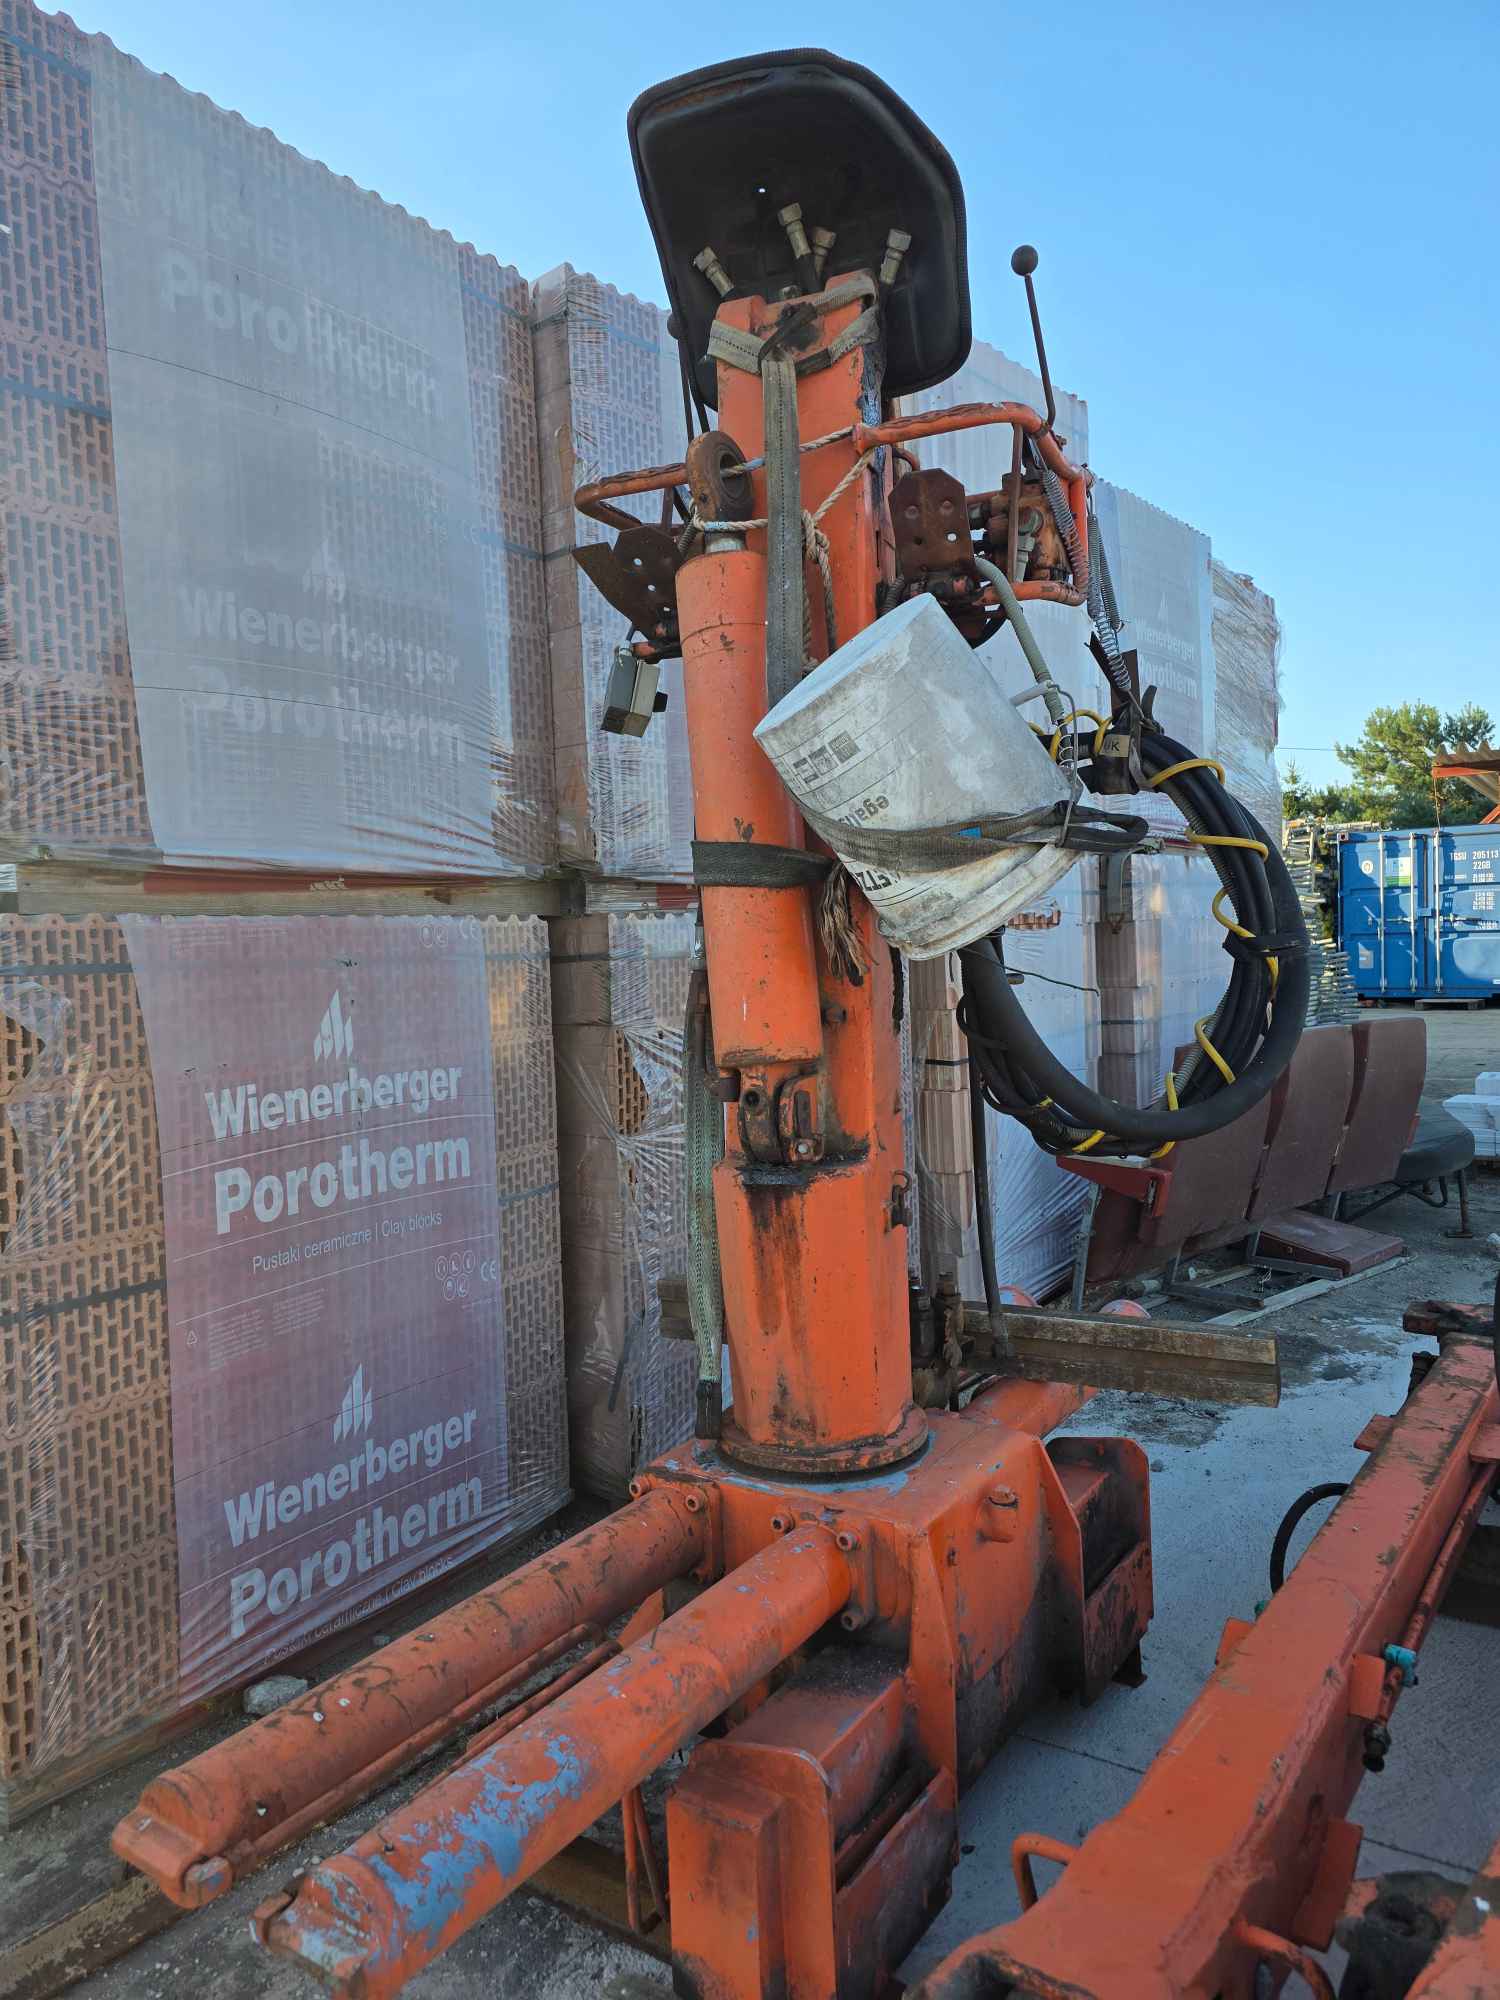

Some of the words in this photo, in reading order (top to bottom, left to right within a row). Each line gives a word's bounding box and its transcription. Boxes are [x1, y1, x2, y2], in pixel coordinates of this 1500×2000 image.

[179, 587, 460, 686] Wienerberger
[182, 664, 465, 762] Porotherm
[204, 1066, 463, 1143] Wienerberger
[214, 1136, 471, 1235] Porotherm
[252, 1245, 301, 1274] Pustaki
[304, 1228, 372, 1259] ceramiczne
[409, 1211, 443, 1232] blocks
[223, 1407, 477, 1548] Wienerberger
[229, 1475, 483, 1640] Porotherm
